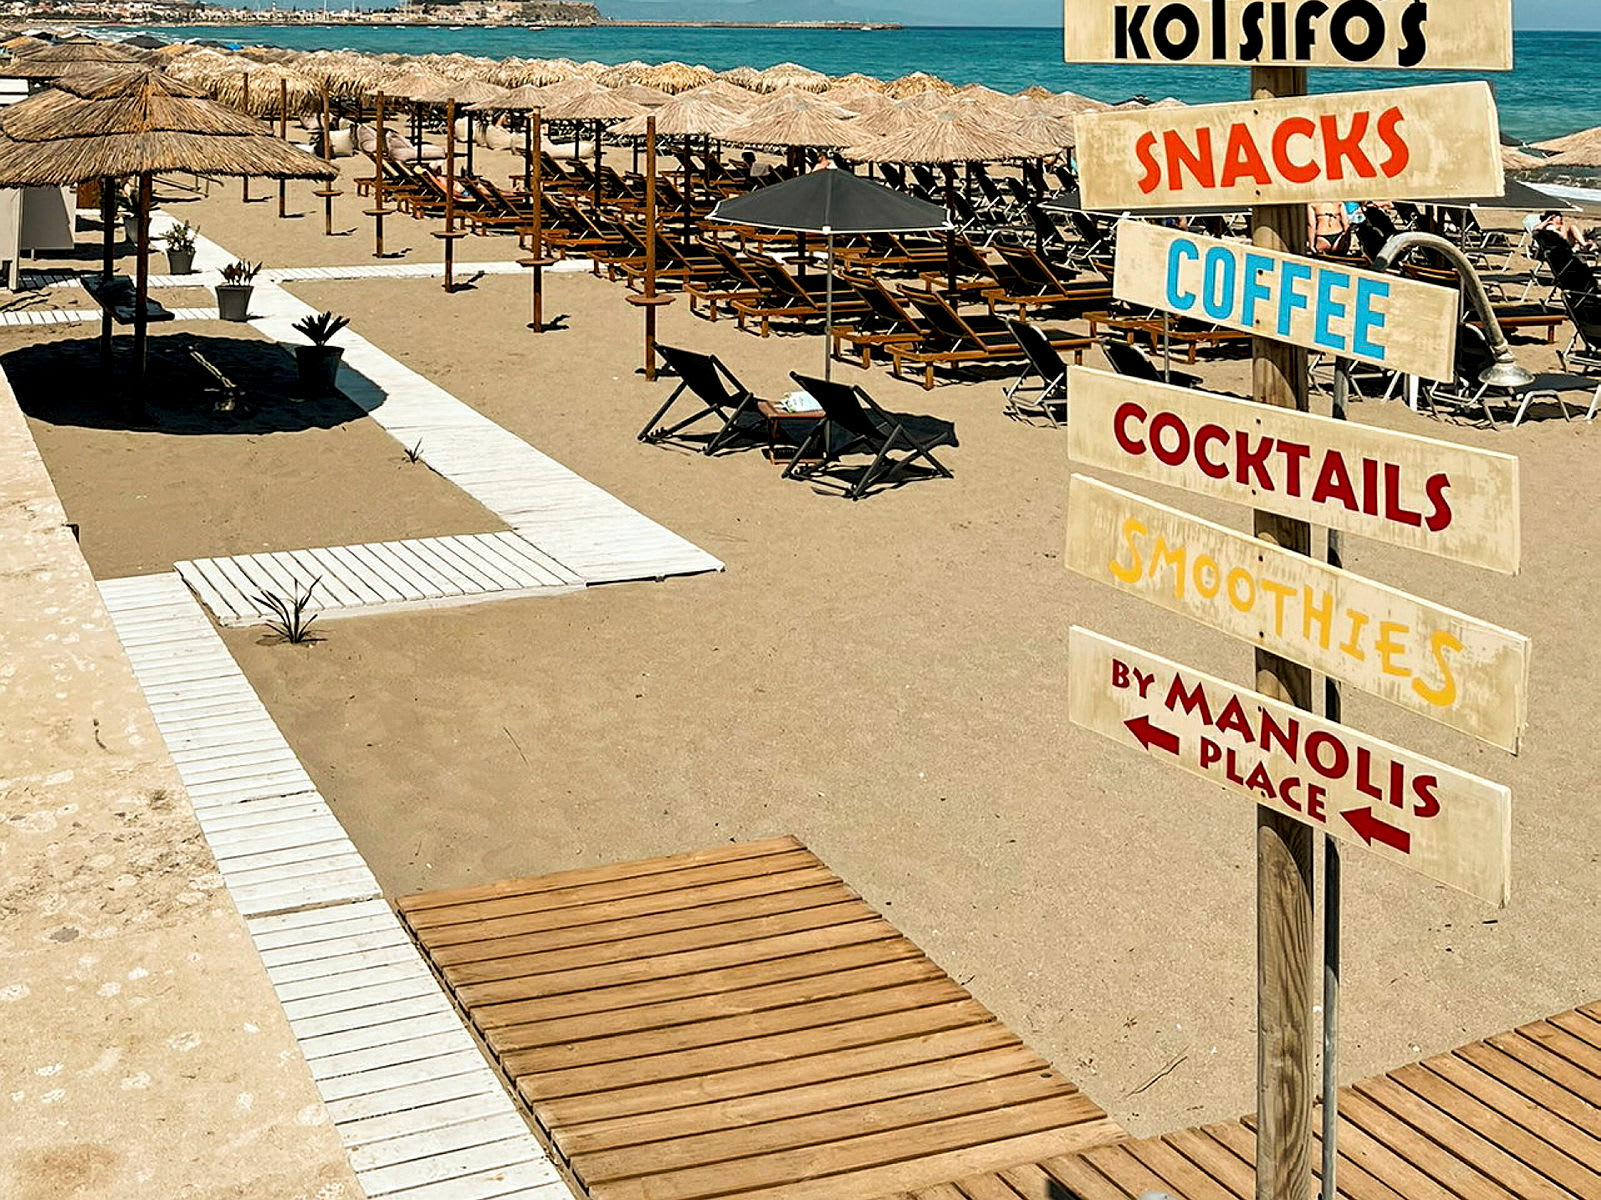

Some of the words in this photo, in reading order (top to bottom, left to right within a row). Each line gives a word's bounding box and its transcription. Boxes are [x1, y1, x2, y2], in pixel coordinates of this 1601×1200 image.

[1135, 106, 1410, 195] SNACKS
[1166, 237, 1391, 361] COFFEE
[1112, 401, 1454, 532] COCKTAILS
[1108, 517, 1465, 707] SMOOTHIES
[1111, 658, 1155, 699] BY
[1165, 672, 1441, 818] MANOLIS
[1200, 736, 1328, 824] PLACE
